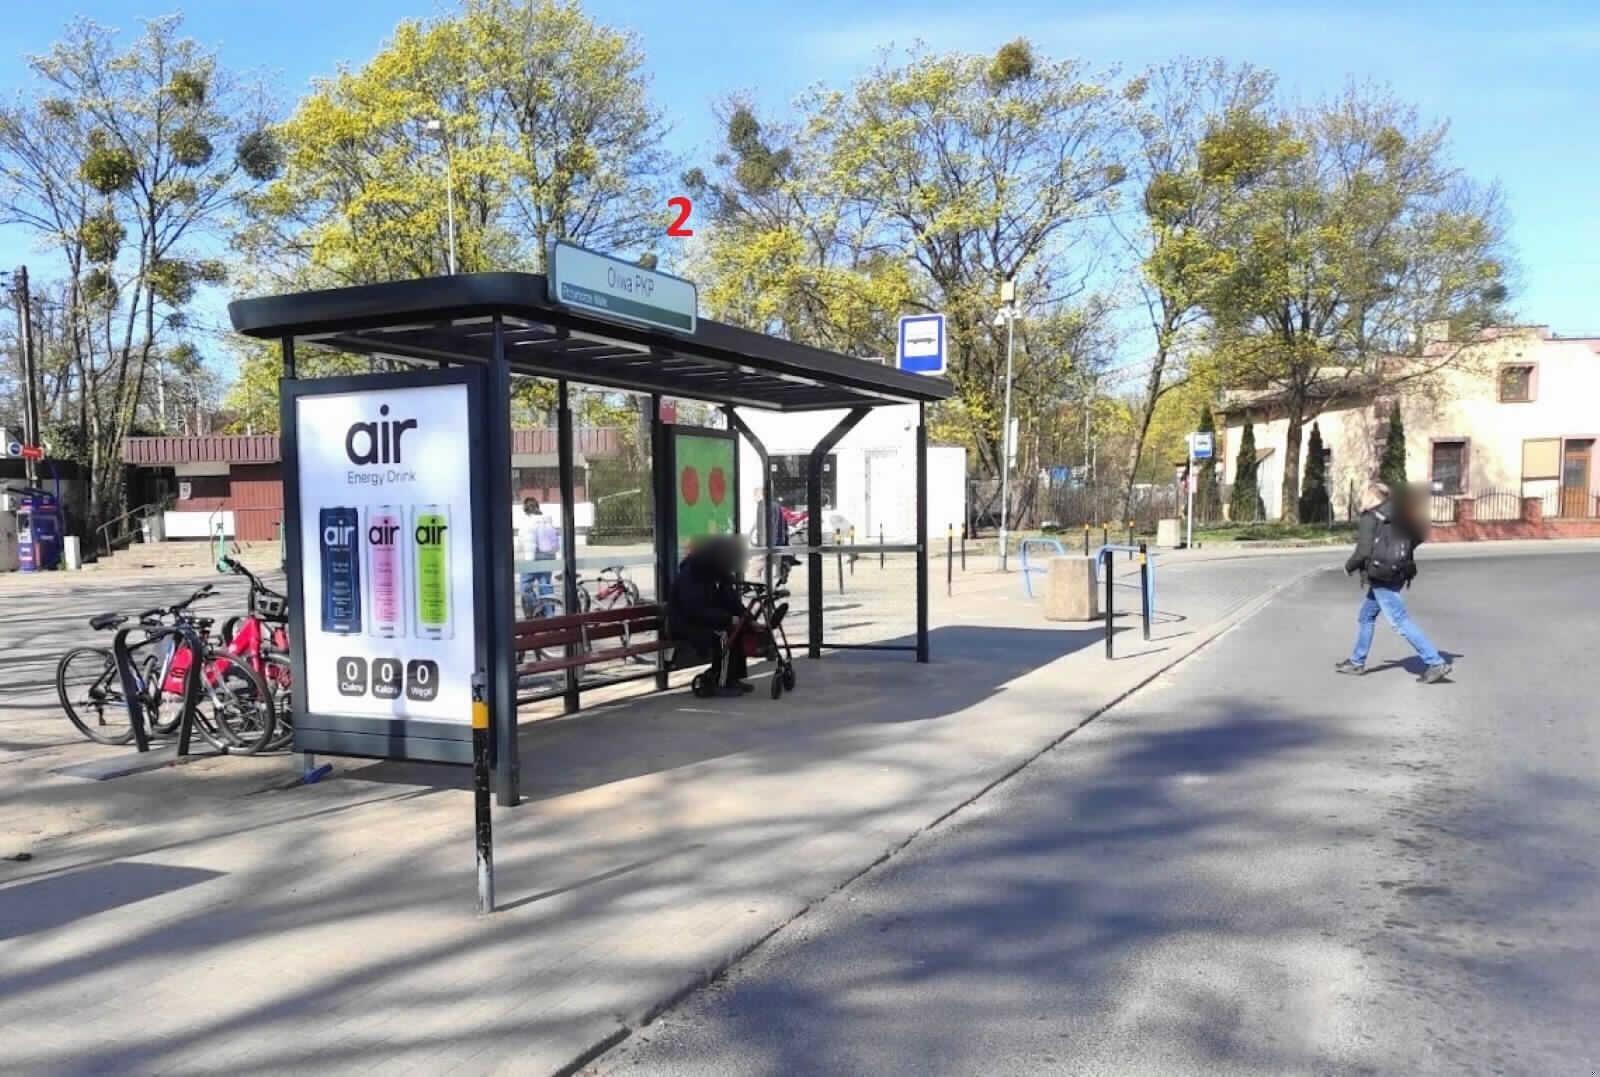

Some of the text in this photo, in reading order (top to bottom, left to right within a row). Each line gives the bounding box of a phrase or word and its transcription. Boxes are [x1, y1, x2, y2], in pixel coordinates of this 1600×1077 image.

[345, 404, 418, 466] air
[347, 469, 417, 486] Energy Drink
[324, 519, 355, 545] air
[368, 519, 400, 545] air
[415, 518, 448, 545] air
[346, 662, 358, 681] 0
[381, 663, 393, 683] 0
[416, 664, 429, 685] 0
